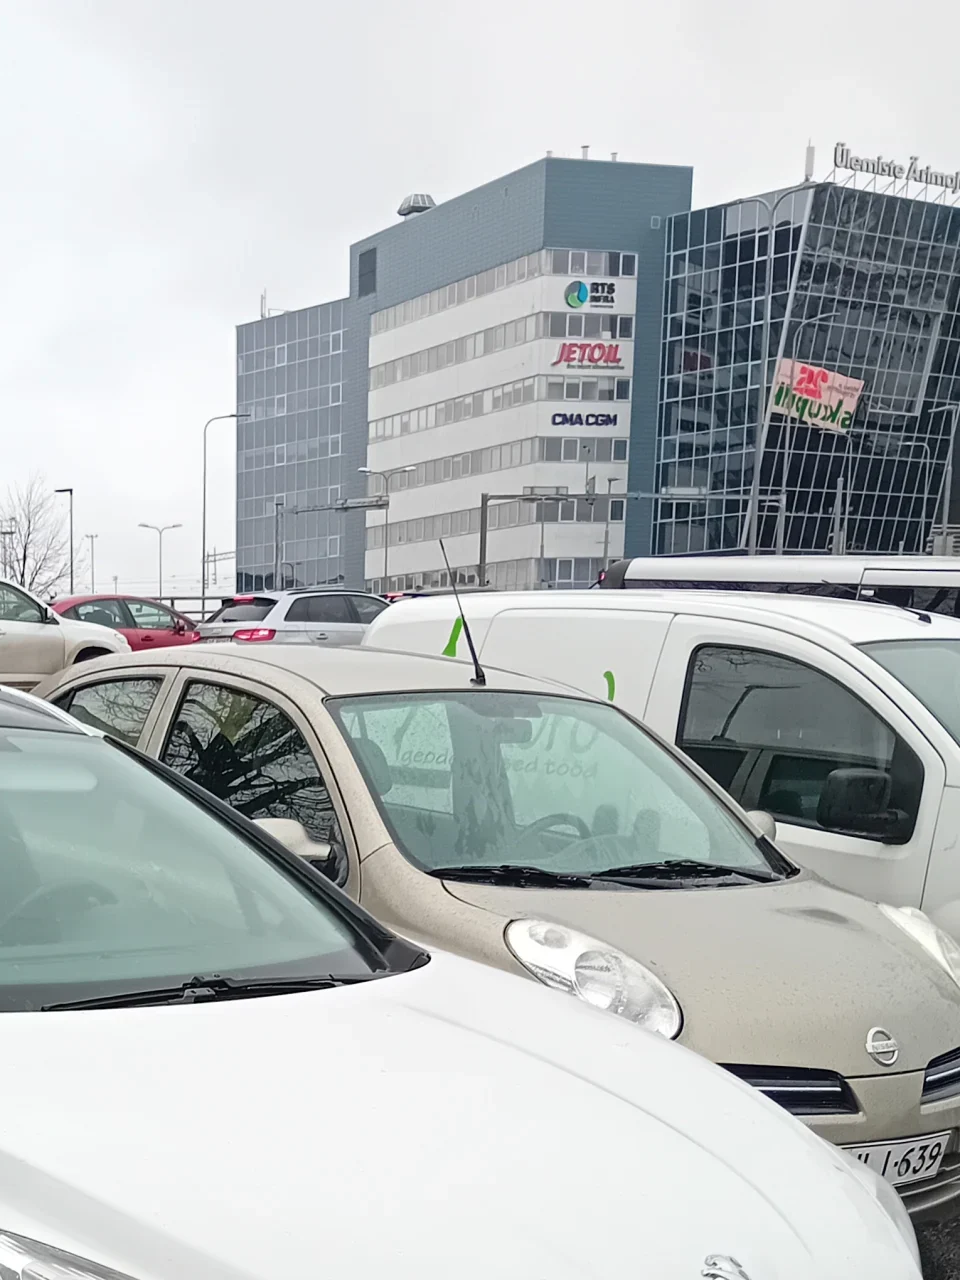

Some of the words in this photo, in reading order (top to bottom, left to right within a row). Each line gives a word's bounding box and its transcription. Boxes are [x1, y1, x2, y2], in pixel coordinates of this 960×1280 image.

[834, 142, 905, 179] Ülemiste
[905, 156, 960, 194] Ärimaj
[590, 282, 615, 294] RTS
[551, 343, 622, 367] JETOIL
[551, 413, 583, 426] CMA
[585, 413, 618, 426] CGM
